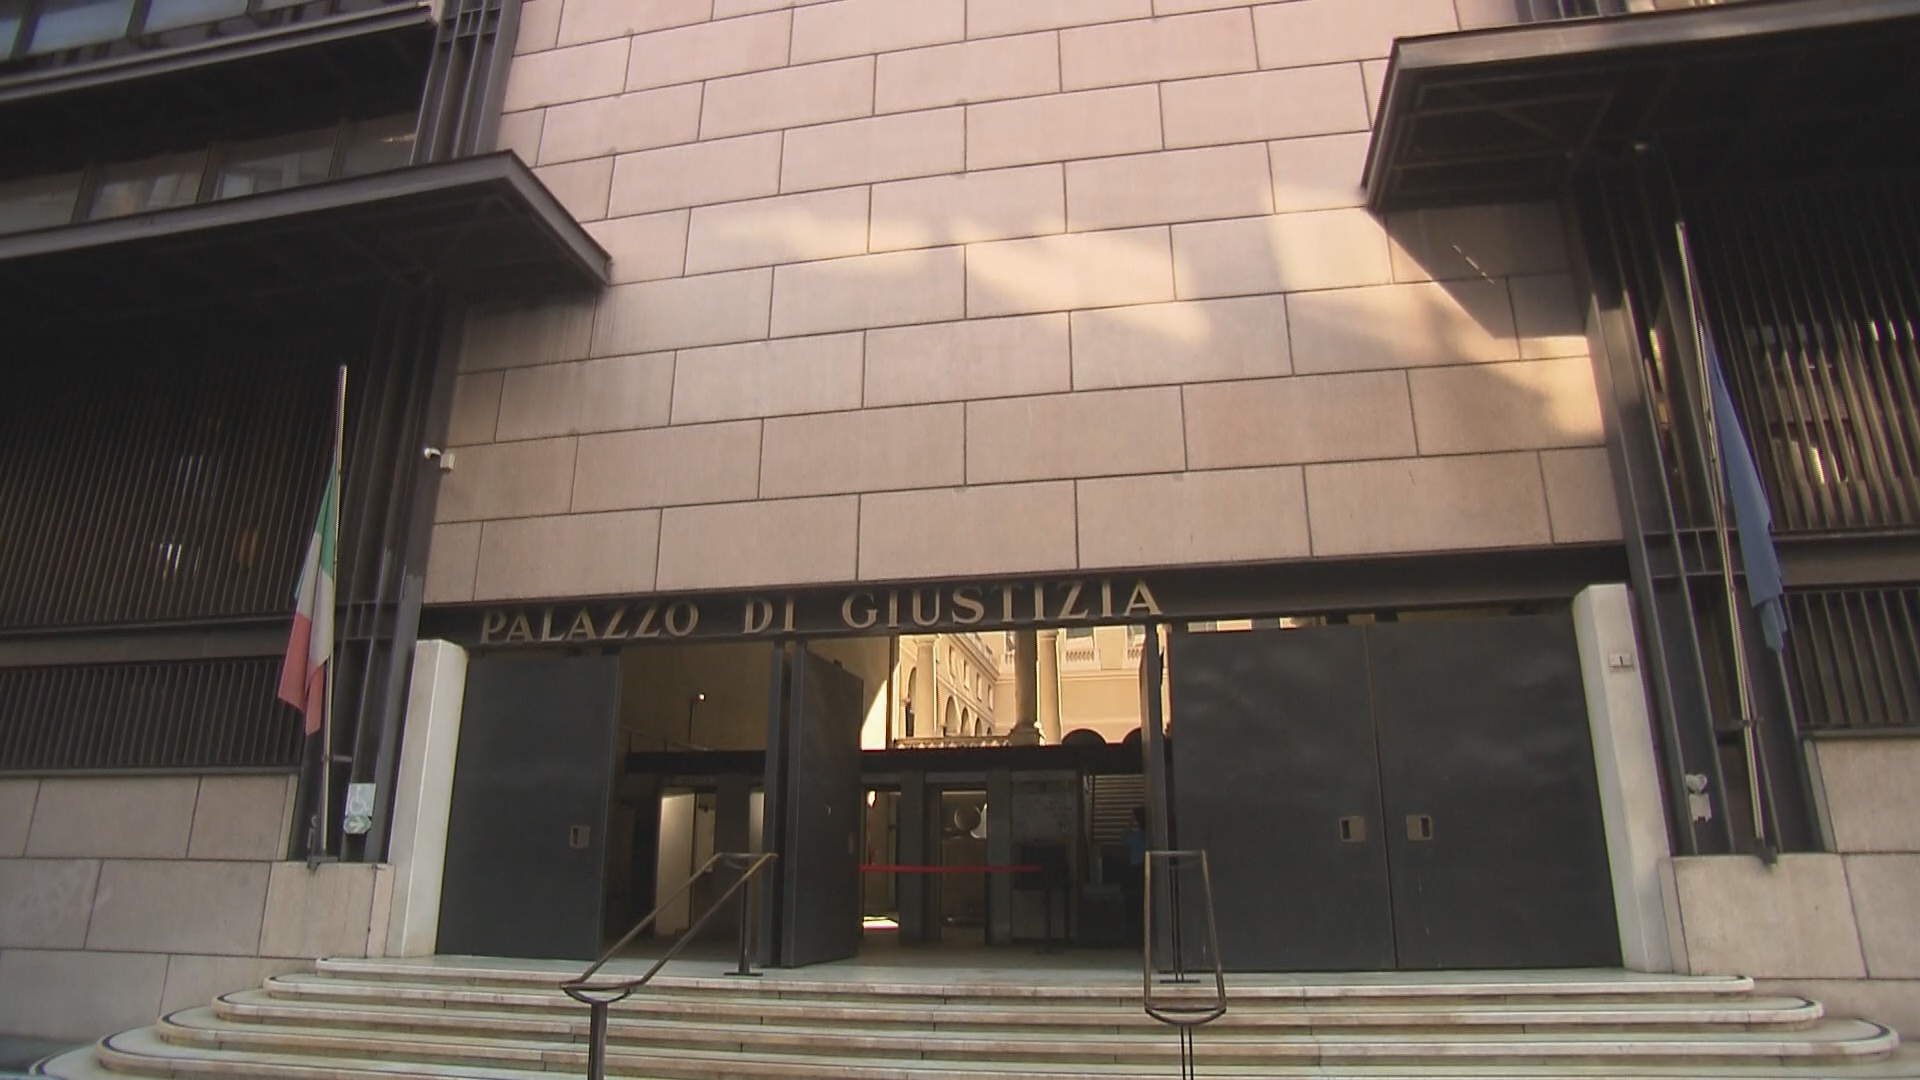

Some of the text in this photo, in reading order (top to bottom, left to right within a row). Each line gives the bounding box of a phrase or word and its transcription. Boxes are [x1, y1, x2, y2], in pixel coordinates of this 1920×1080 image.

[479, 577, 1164, 644] PALAZZO DI GIUSTIZIA
